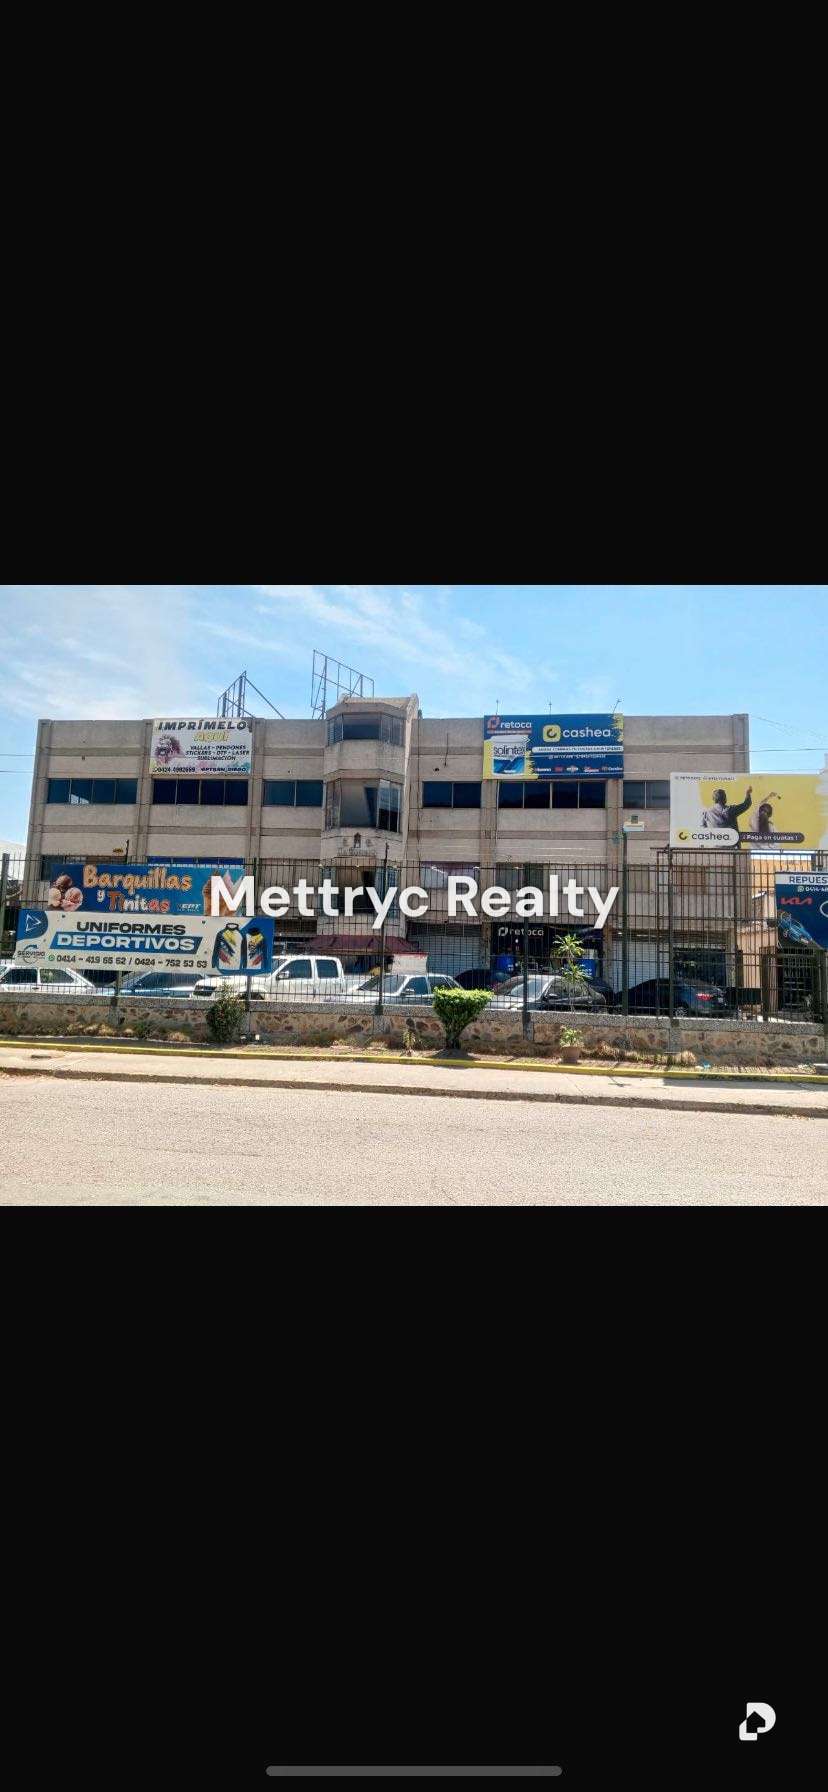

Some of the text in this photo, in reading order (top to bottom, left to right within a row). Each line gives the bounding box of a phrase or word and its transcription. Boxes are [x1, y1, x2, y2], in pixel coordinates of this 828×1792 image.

[158, 719, 247, 730] IMPRÍMELO
[83, 864, 192, 895] Barquillas
[76, 921, 186, 935] UNIFORMES
[57, 935, 195, 951] DEPORTIVOS
[57, 955, 76, 963] 0414
[86, 956, 101, 964] 419
[135, 958, 155, 966] 0424
[165, 959, 181, 967] 752
